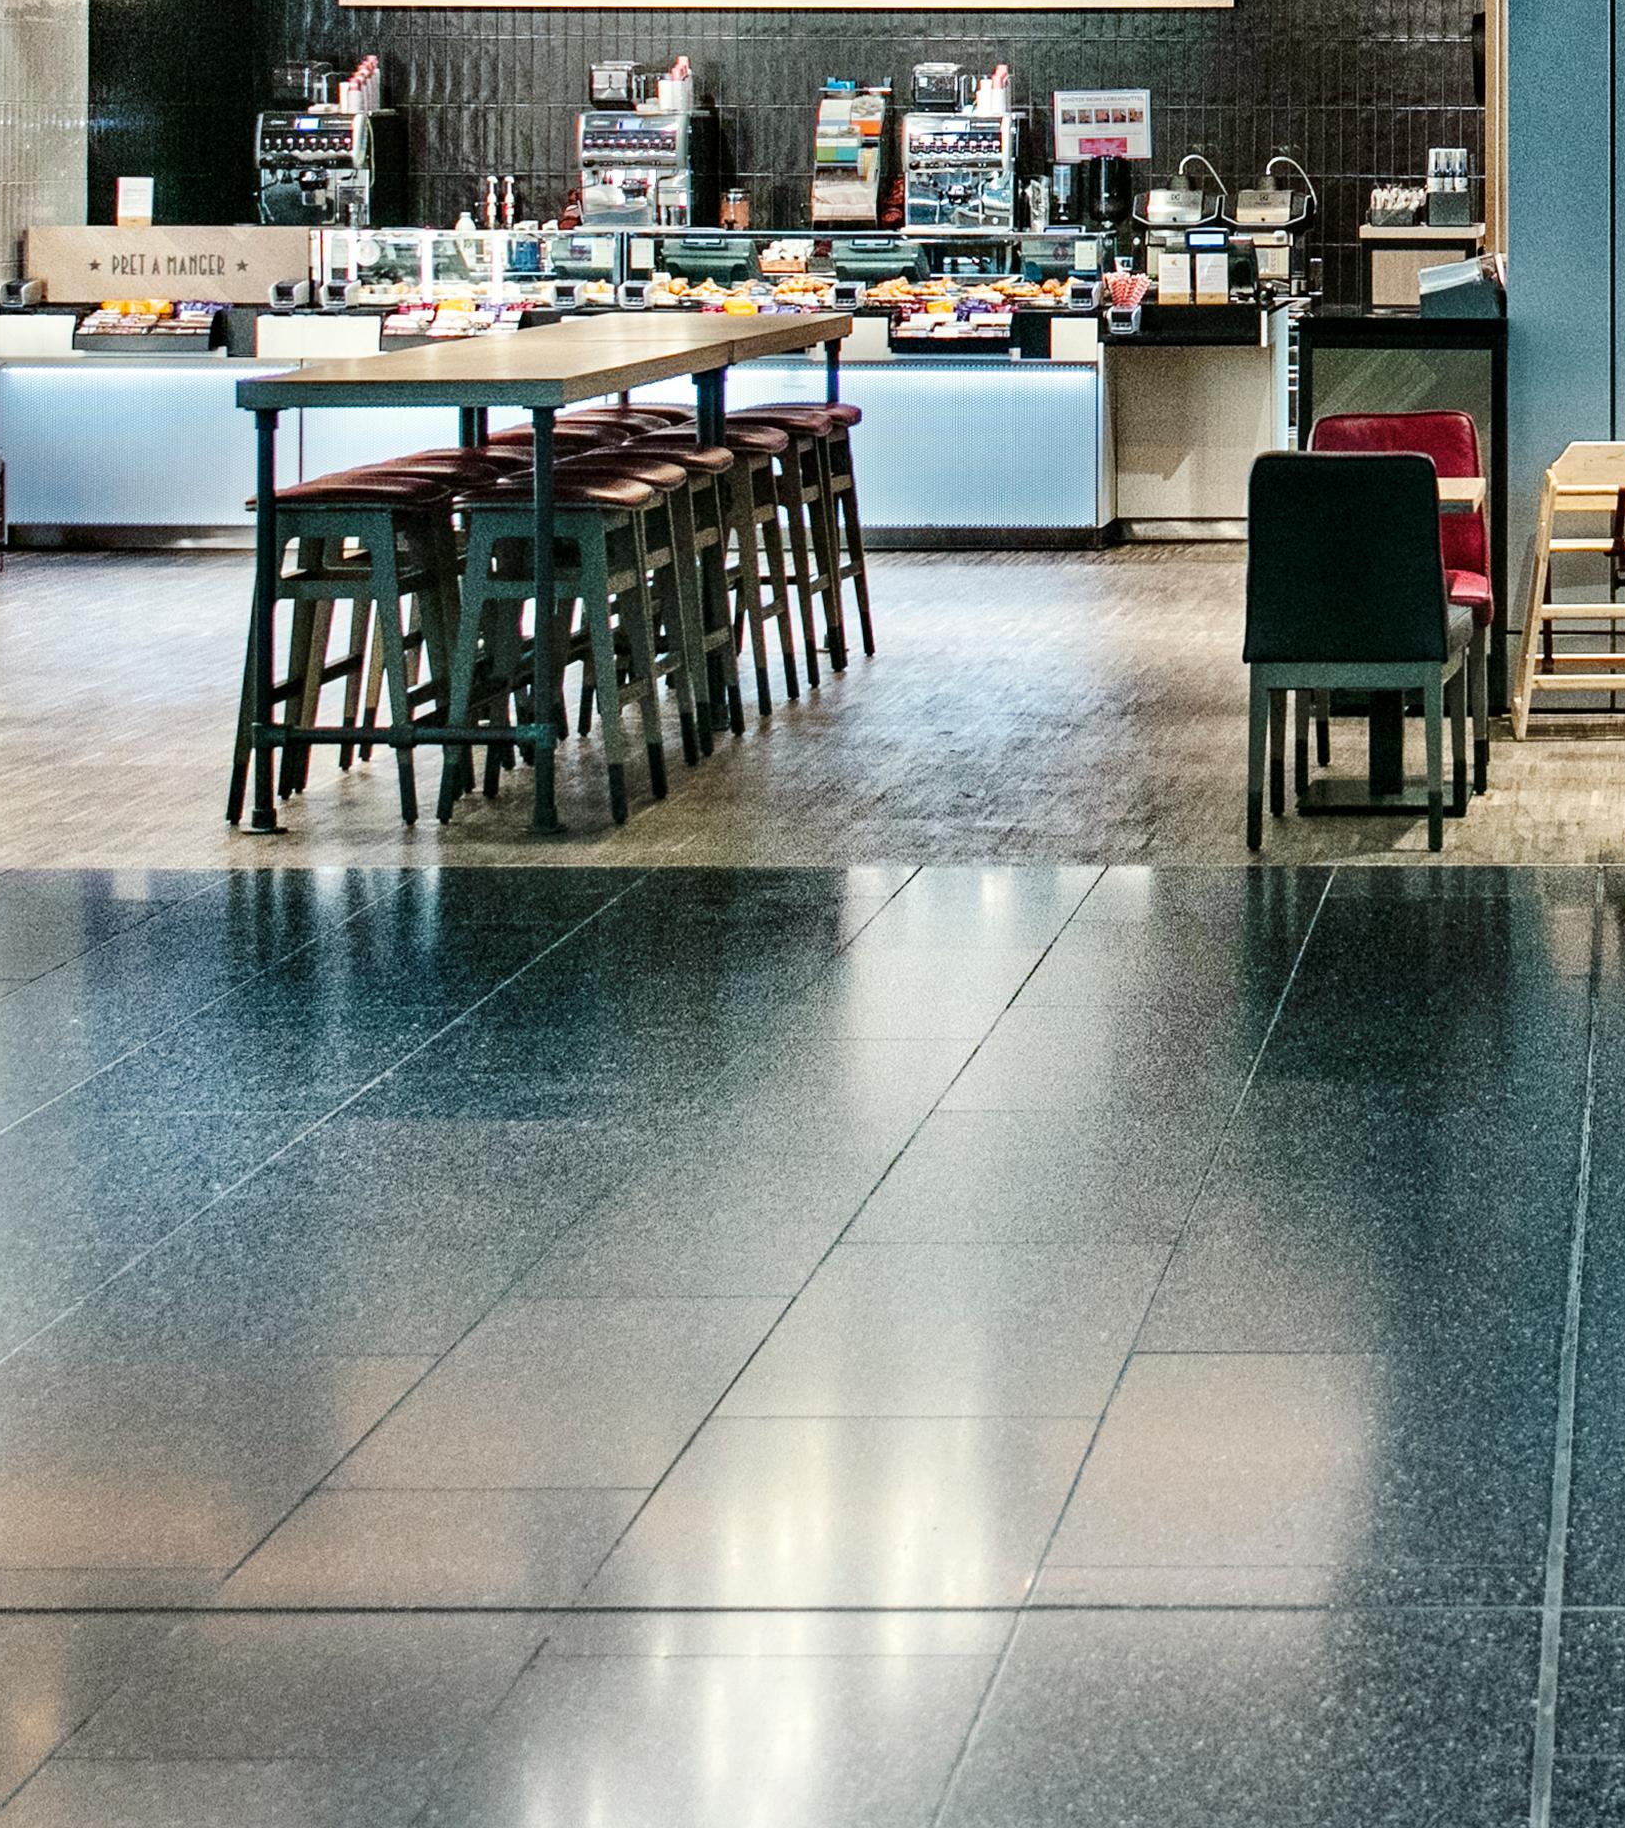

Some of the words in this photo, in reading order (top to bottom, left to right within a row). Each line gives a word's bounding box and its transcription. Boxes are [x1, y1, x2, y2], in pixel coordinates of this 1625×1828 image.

[112, 254, 146, 276] PRET
[151, 256, 161, 276] A
[167, 254, 225, 276] MANGER
